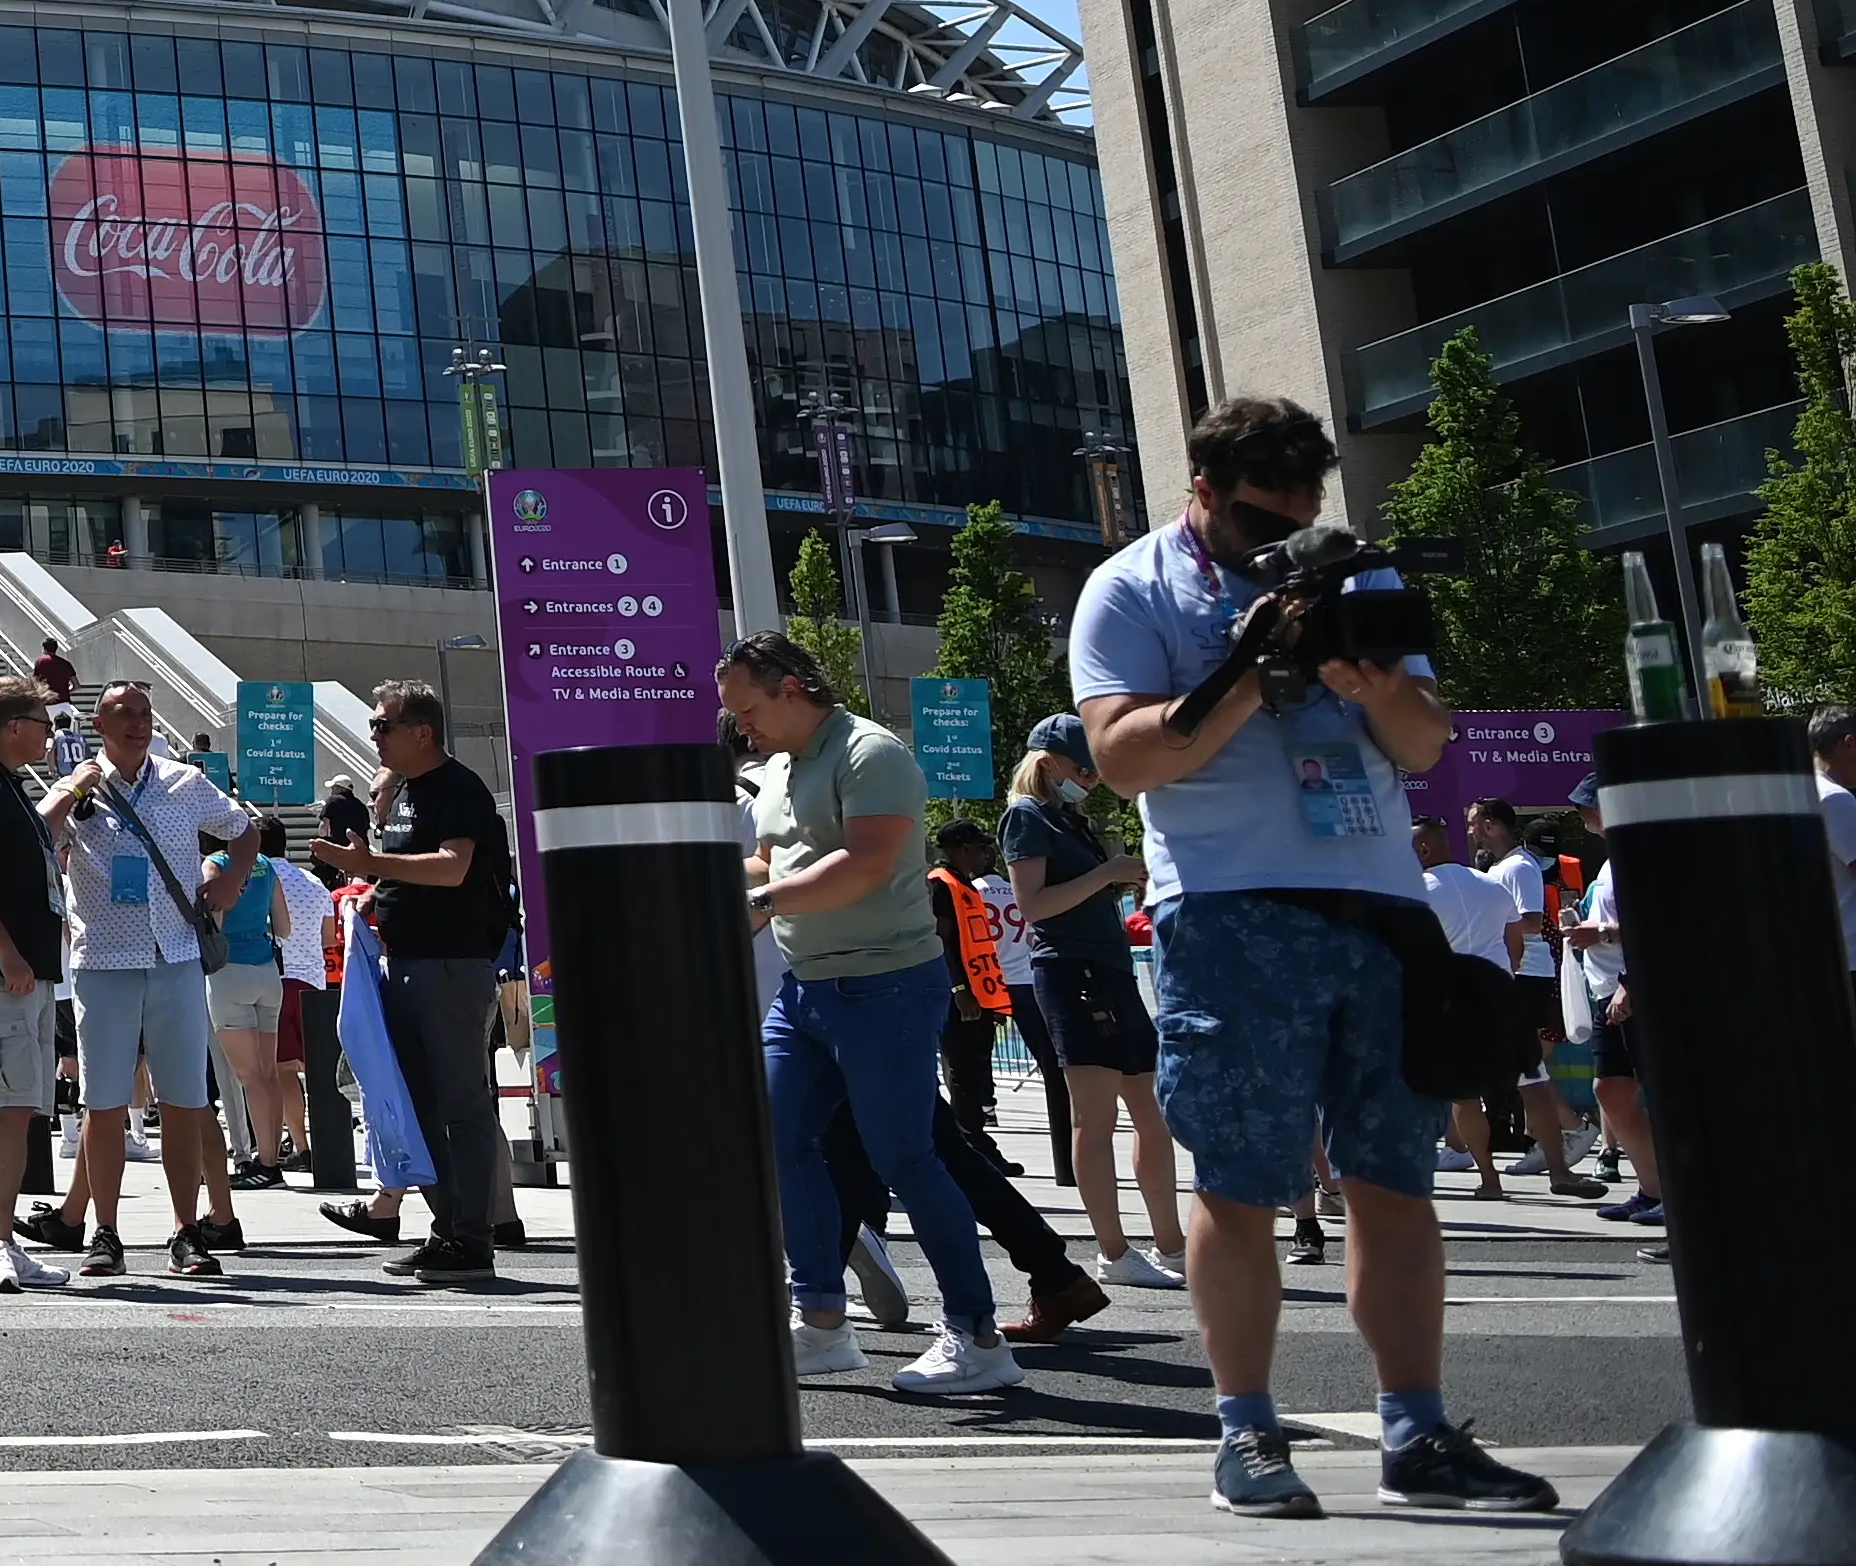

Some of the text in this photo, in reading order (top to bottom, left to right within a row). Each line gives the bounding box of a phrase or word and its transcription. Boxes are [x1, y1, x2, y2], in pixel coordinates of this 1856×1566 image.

[25, 460, 61, 472] EURO
[62, 461, 95, 473] 2020
[283, 469, 380, 484] UEFA EURO 2020
[776, 497, 800, 510] UEFA
[542, 558, 603, 571] Entrance
[546, 601, 614, 613] Entrances
[549, 644, 610, 656] Entrance
[552, 666, 666, 678] Accessible Route
[552, 688, 695, 700] TV & Media Entrance
[248, 710, 304, 721] Prepare for
[922, 706, 979, 717] Prepare for
[258, 722, 294, 731] checks:
[933, 718, 969, 727] checks:
[1467, 727, 1529, 740] Entrance
[61, 741, 84, 763] 10
[246, 748, 306, 759] Covid status
[922, 744, 983, 754] Covid status
[1469, 750, 1594, 763] TV & Media Entra
[258, 776, 293, 786] Tickets
[936, 772, 971, 781] Tickets
